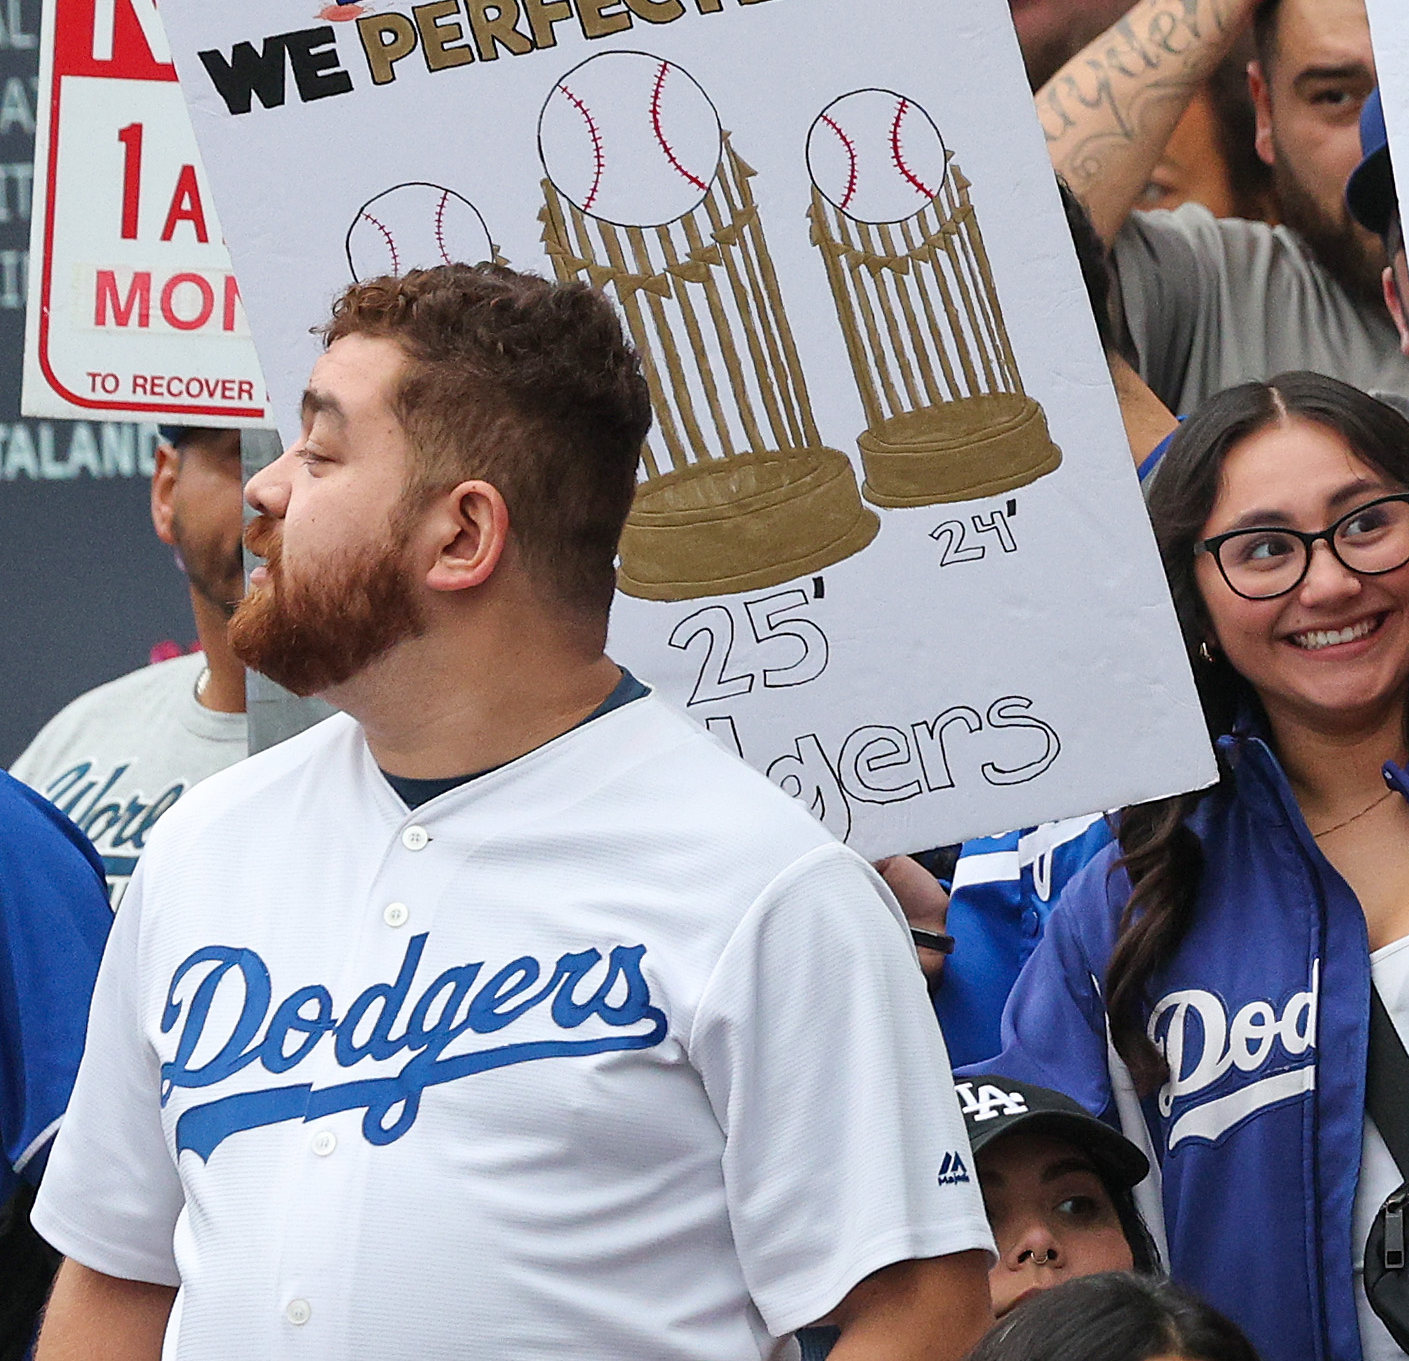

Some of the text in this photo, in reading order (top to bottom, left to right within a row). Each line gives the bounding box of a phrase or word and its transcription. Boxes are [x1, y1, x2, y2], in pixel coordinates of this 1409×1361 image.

[200, 26, 354, 115] WE
[87, 372, 254, 401] TO RECOVER
[929, 499, 1017, 567] 24'
[668, 576, 829, 708] 25'
[160, 932, 669, 1160] Dodgers
[954, 1082, 1029, 1122] LA
